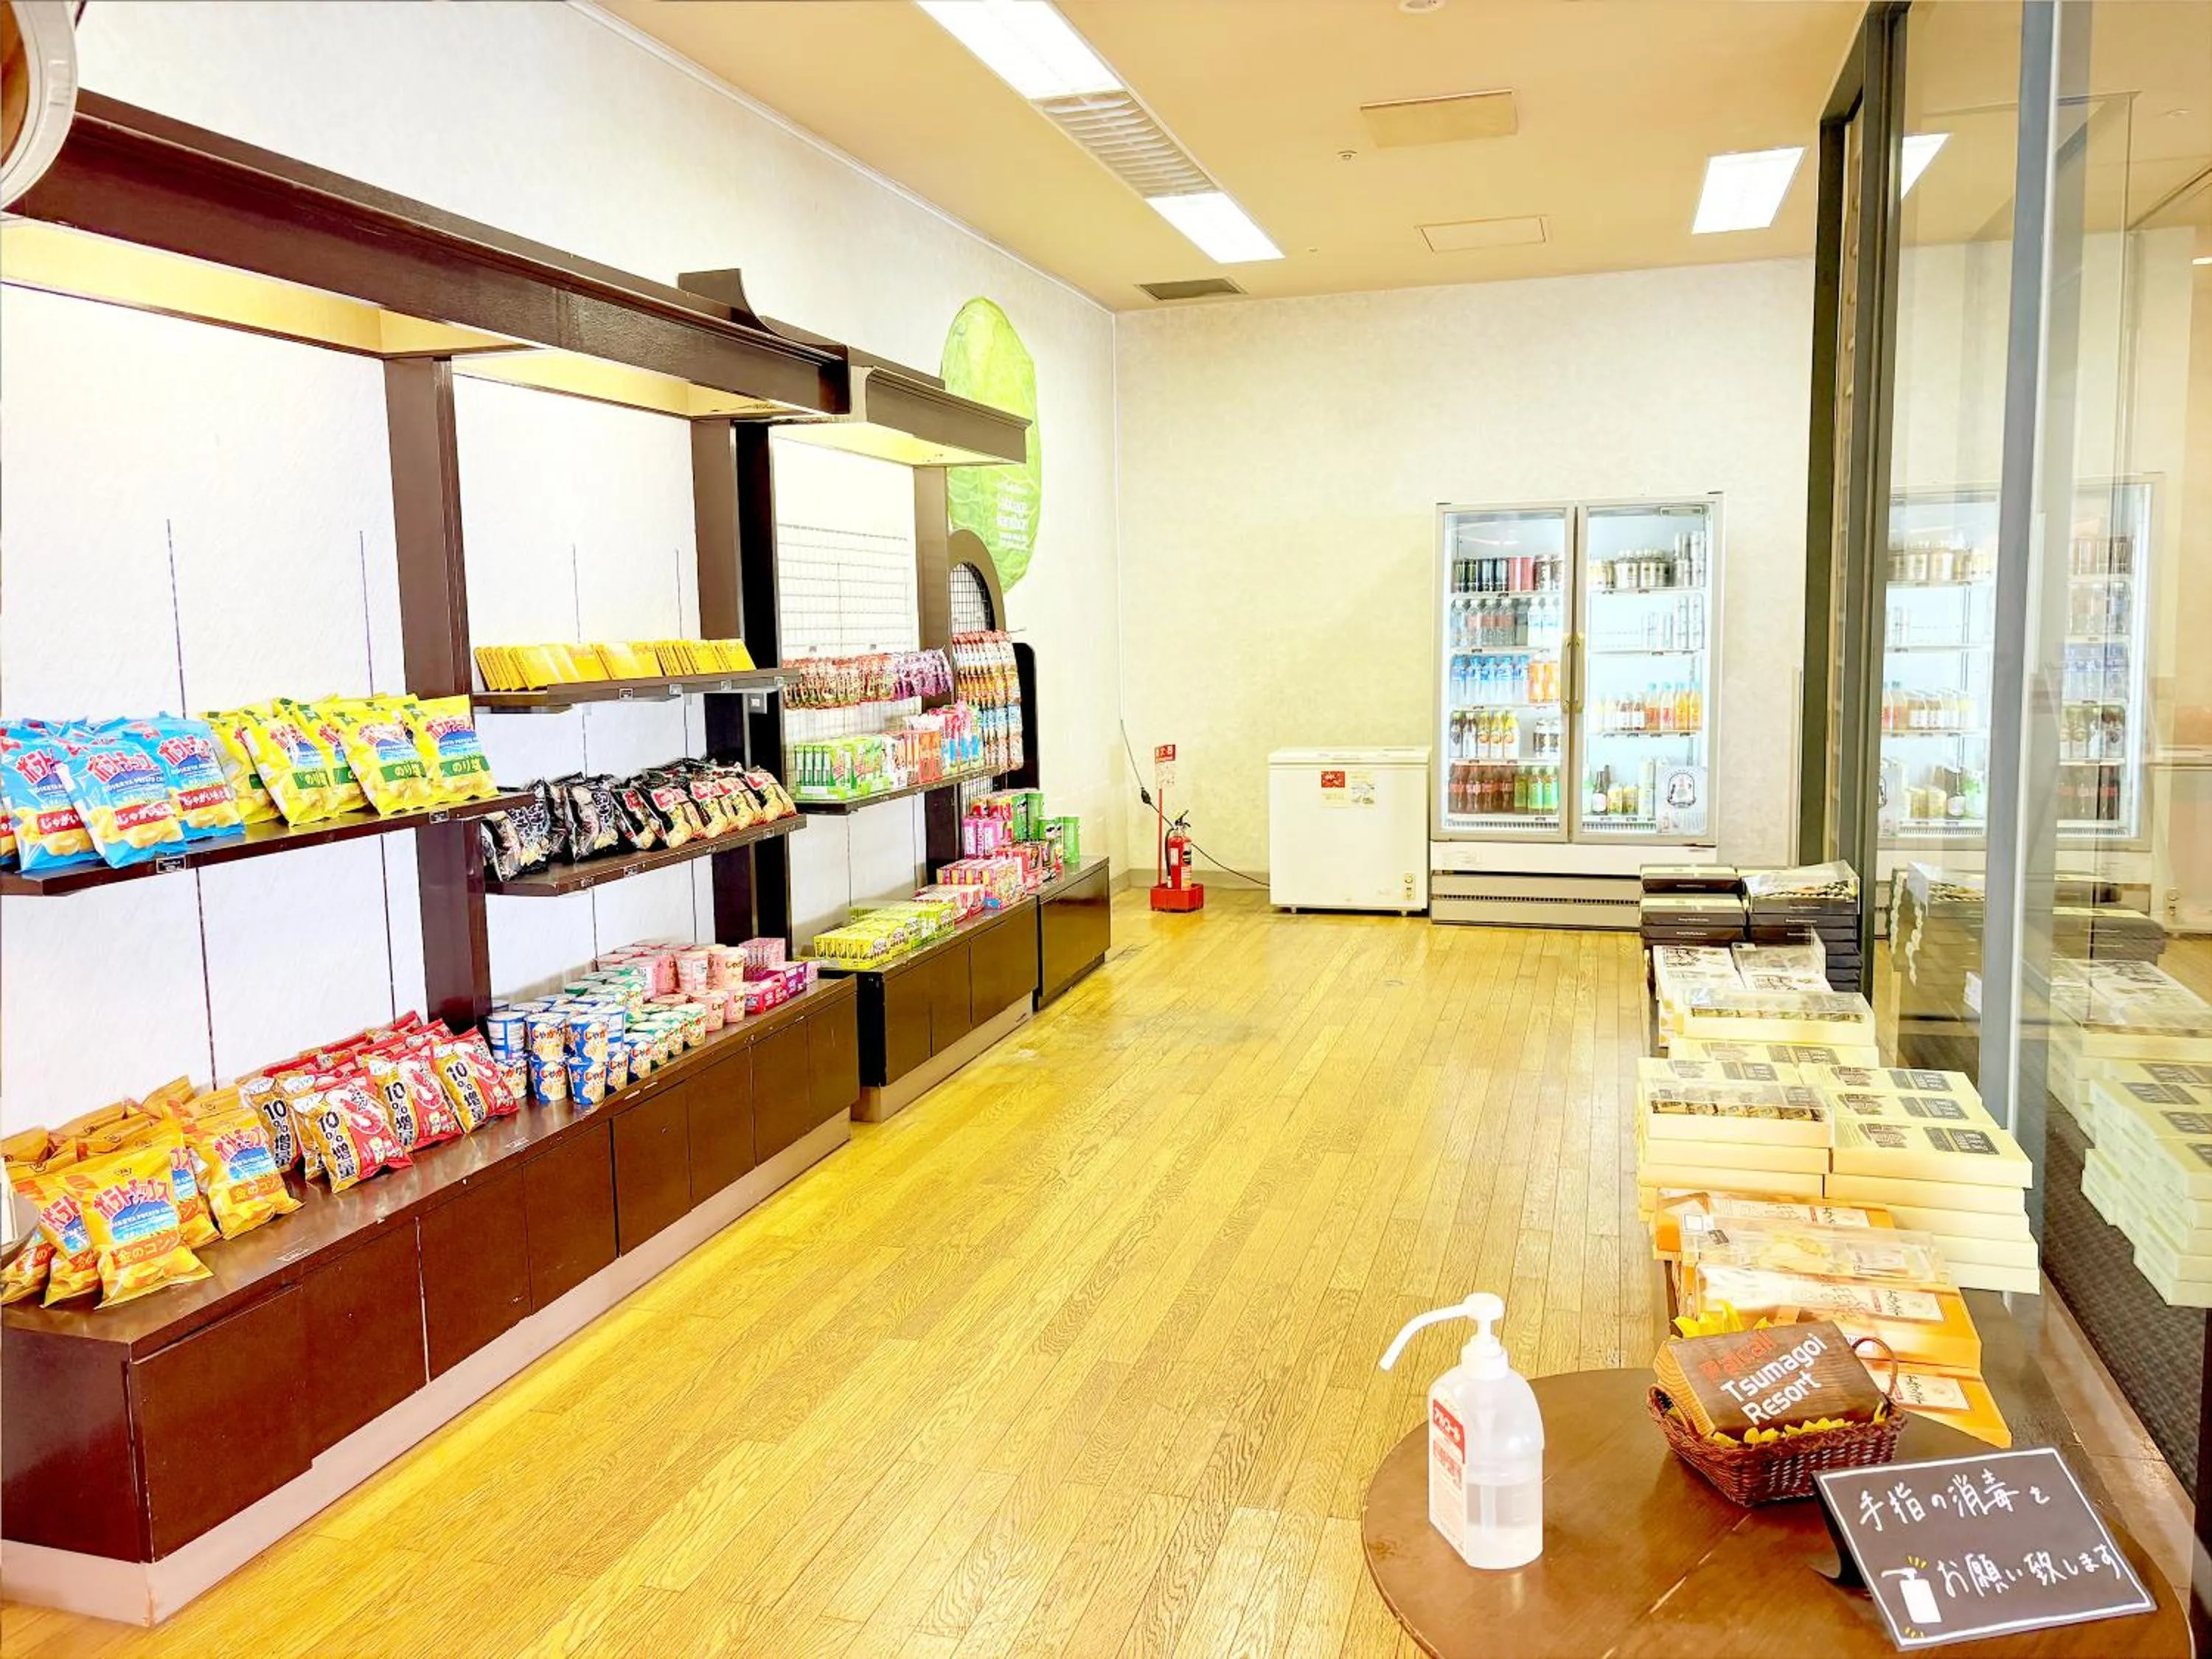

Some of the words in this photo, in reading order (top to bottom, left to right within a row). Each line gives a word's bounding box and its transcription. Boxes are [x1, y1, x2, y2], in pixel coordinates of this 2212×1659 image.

[1719, 1332, 1828, 1402] Tsumagoi
[1741, 1370, 1823, 1425] Resort
[1860, 1468, 2051, 1532] 手指の消毒を
[1937, 1544, 2122, 1598] お願い致します
